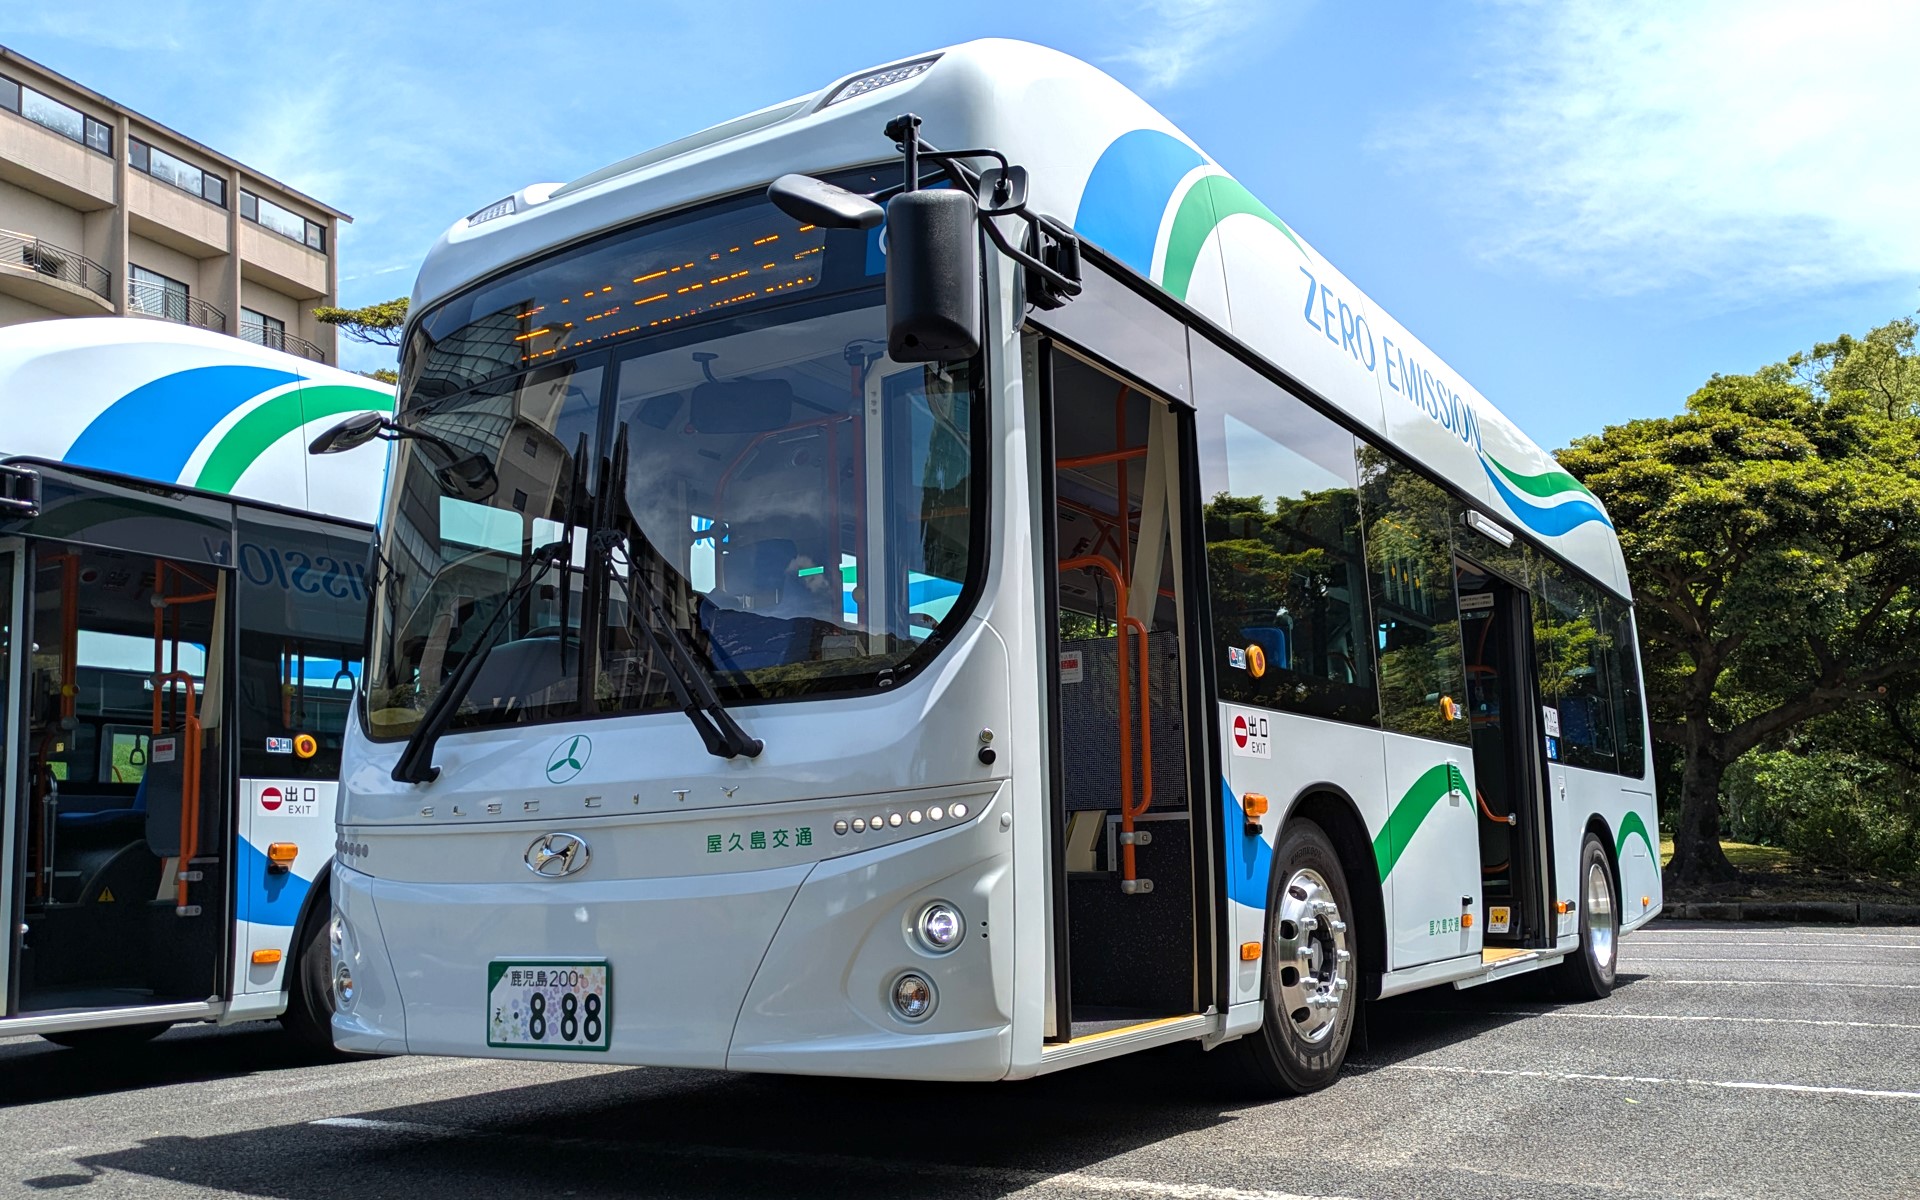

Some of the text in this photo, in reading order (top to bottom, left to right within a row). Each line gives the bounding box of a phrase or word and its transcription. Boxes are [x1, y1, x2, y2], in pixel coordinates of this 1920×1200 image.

[1300, 265, 1482, 453] ZERO EMISSION
[1248, 715, 1268, 738] 出口
[1252, 741, 1267, 755] EXIT
[285, 786, 316, 802] 出口
[421, 785, 740, 818] ELEC CITY
[288, 805, 312, 815] EXIT
[706, 827, 813, 853] 屋久島交通
[1429, 916, 1460, 936] 屋久島交通
[495, 1007, 503, 1023] え
